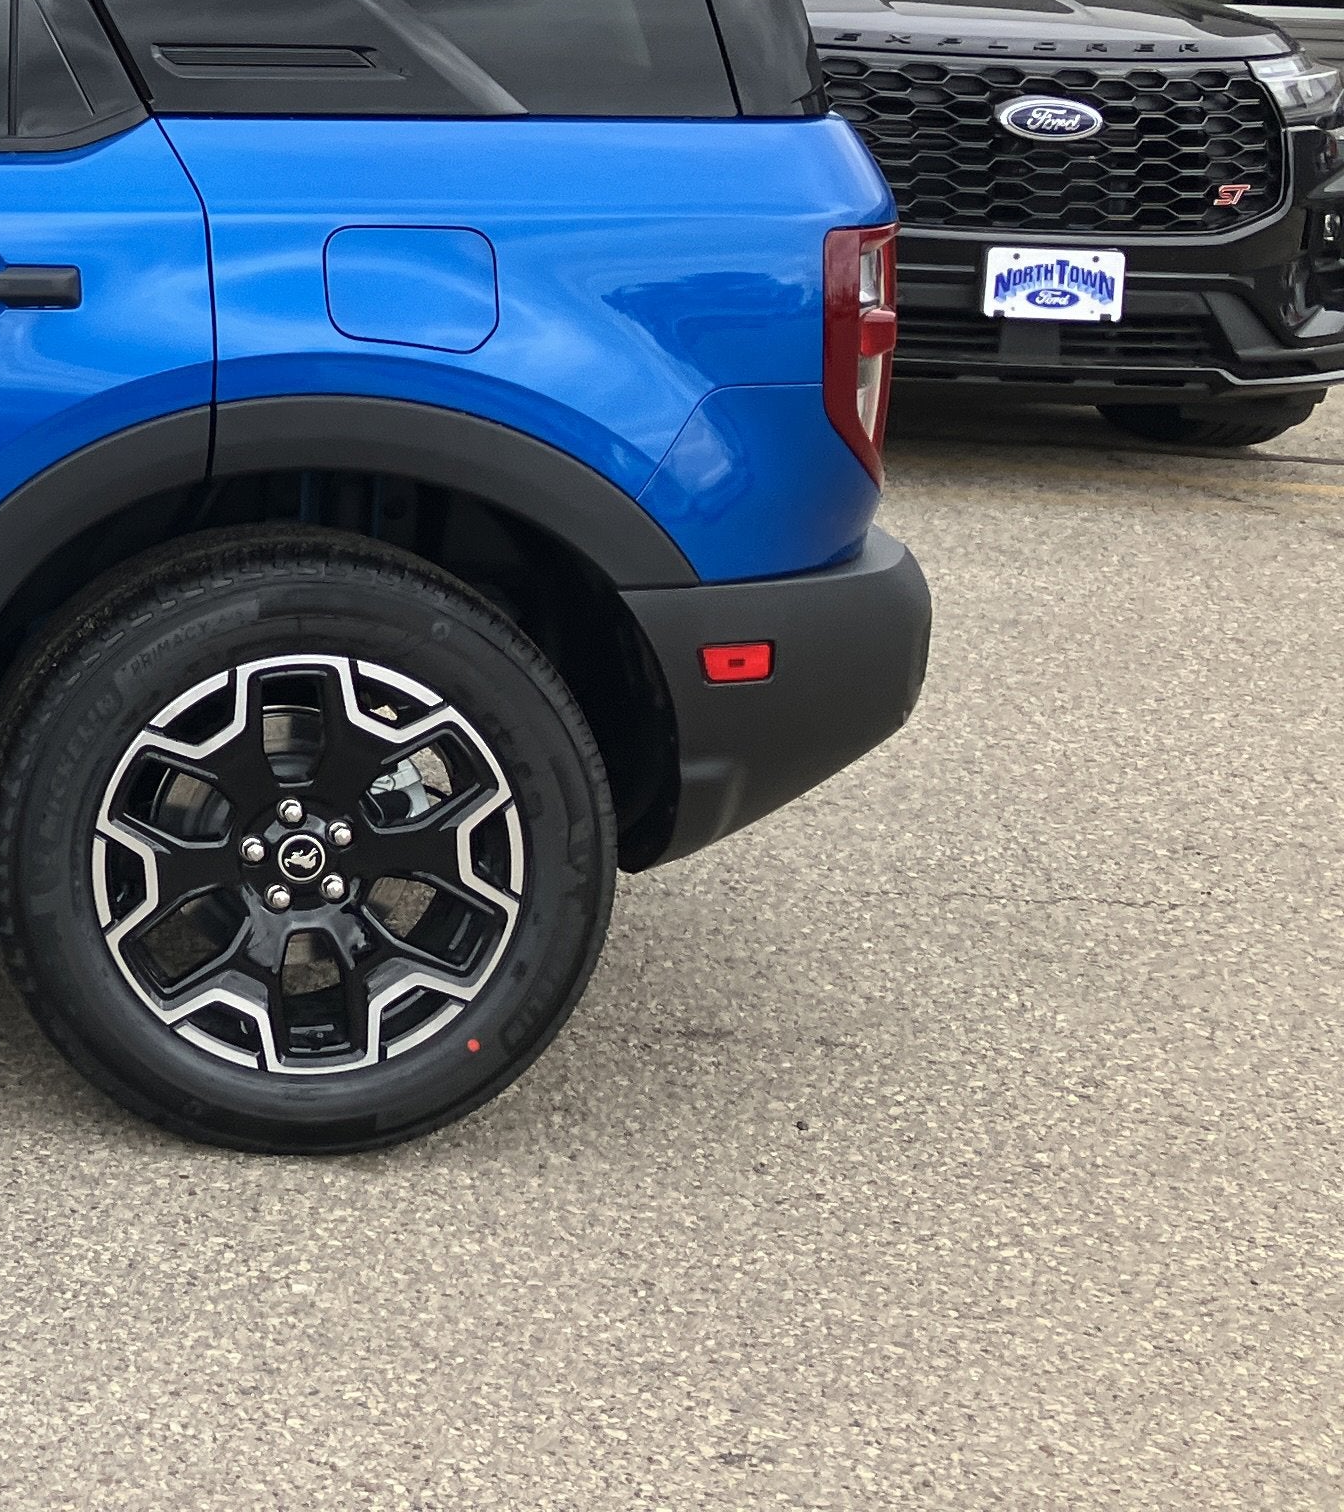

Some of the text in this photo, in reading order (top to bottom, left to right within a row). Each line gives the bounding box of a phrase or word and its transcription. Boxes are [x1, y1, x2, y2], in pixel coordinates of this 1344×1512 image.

[832, 30, 1200, 54] EXPLORER
[1026, 106, 1081, 131] Ford
[1213, 184, 1251, 206] ST
[1034, 290, 1070, 306] Ford
